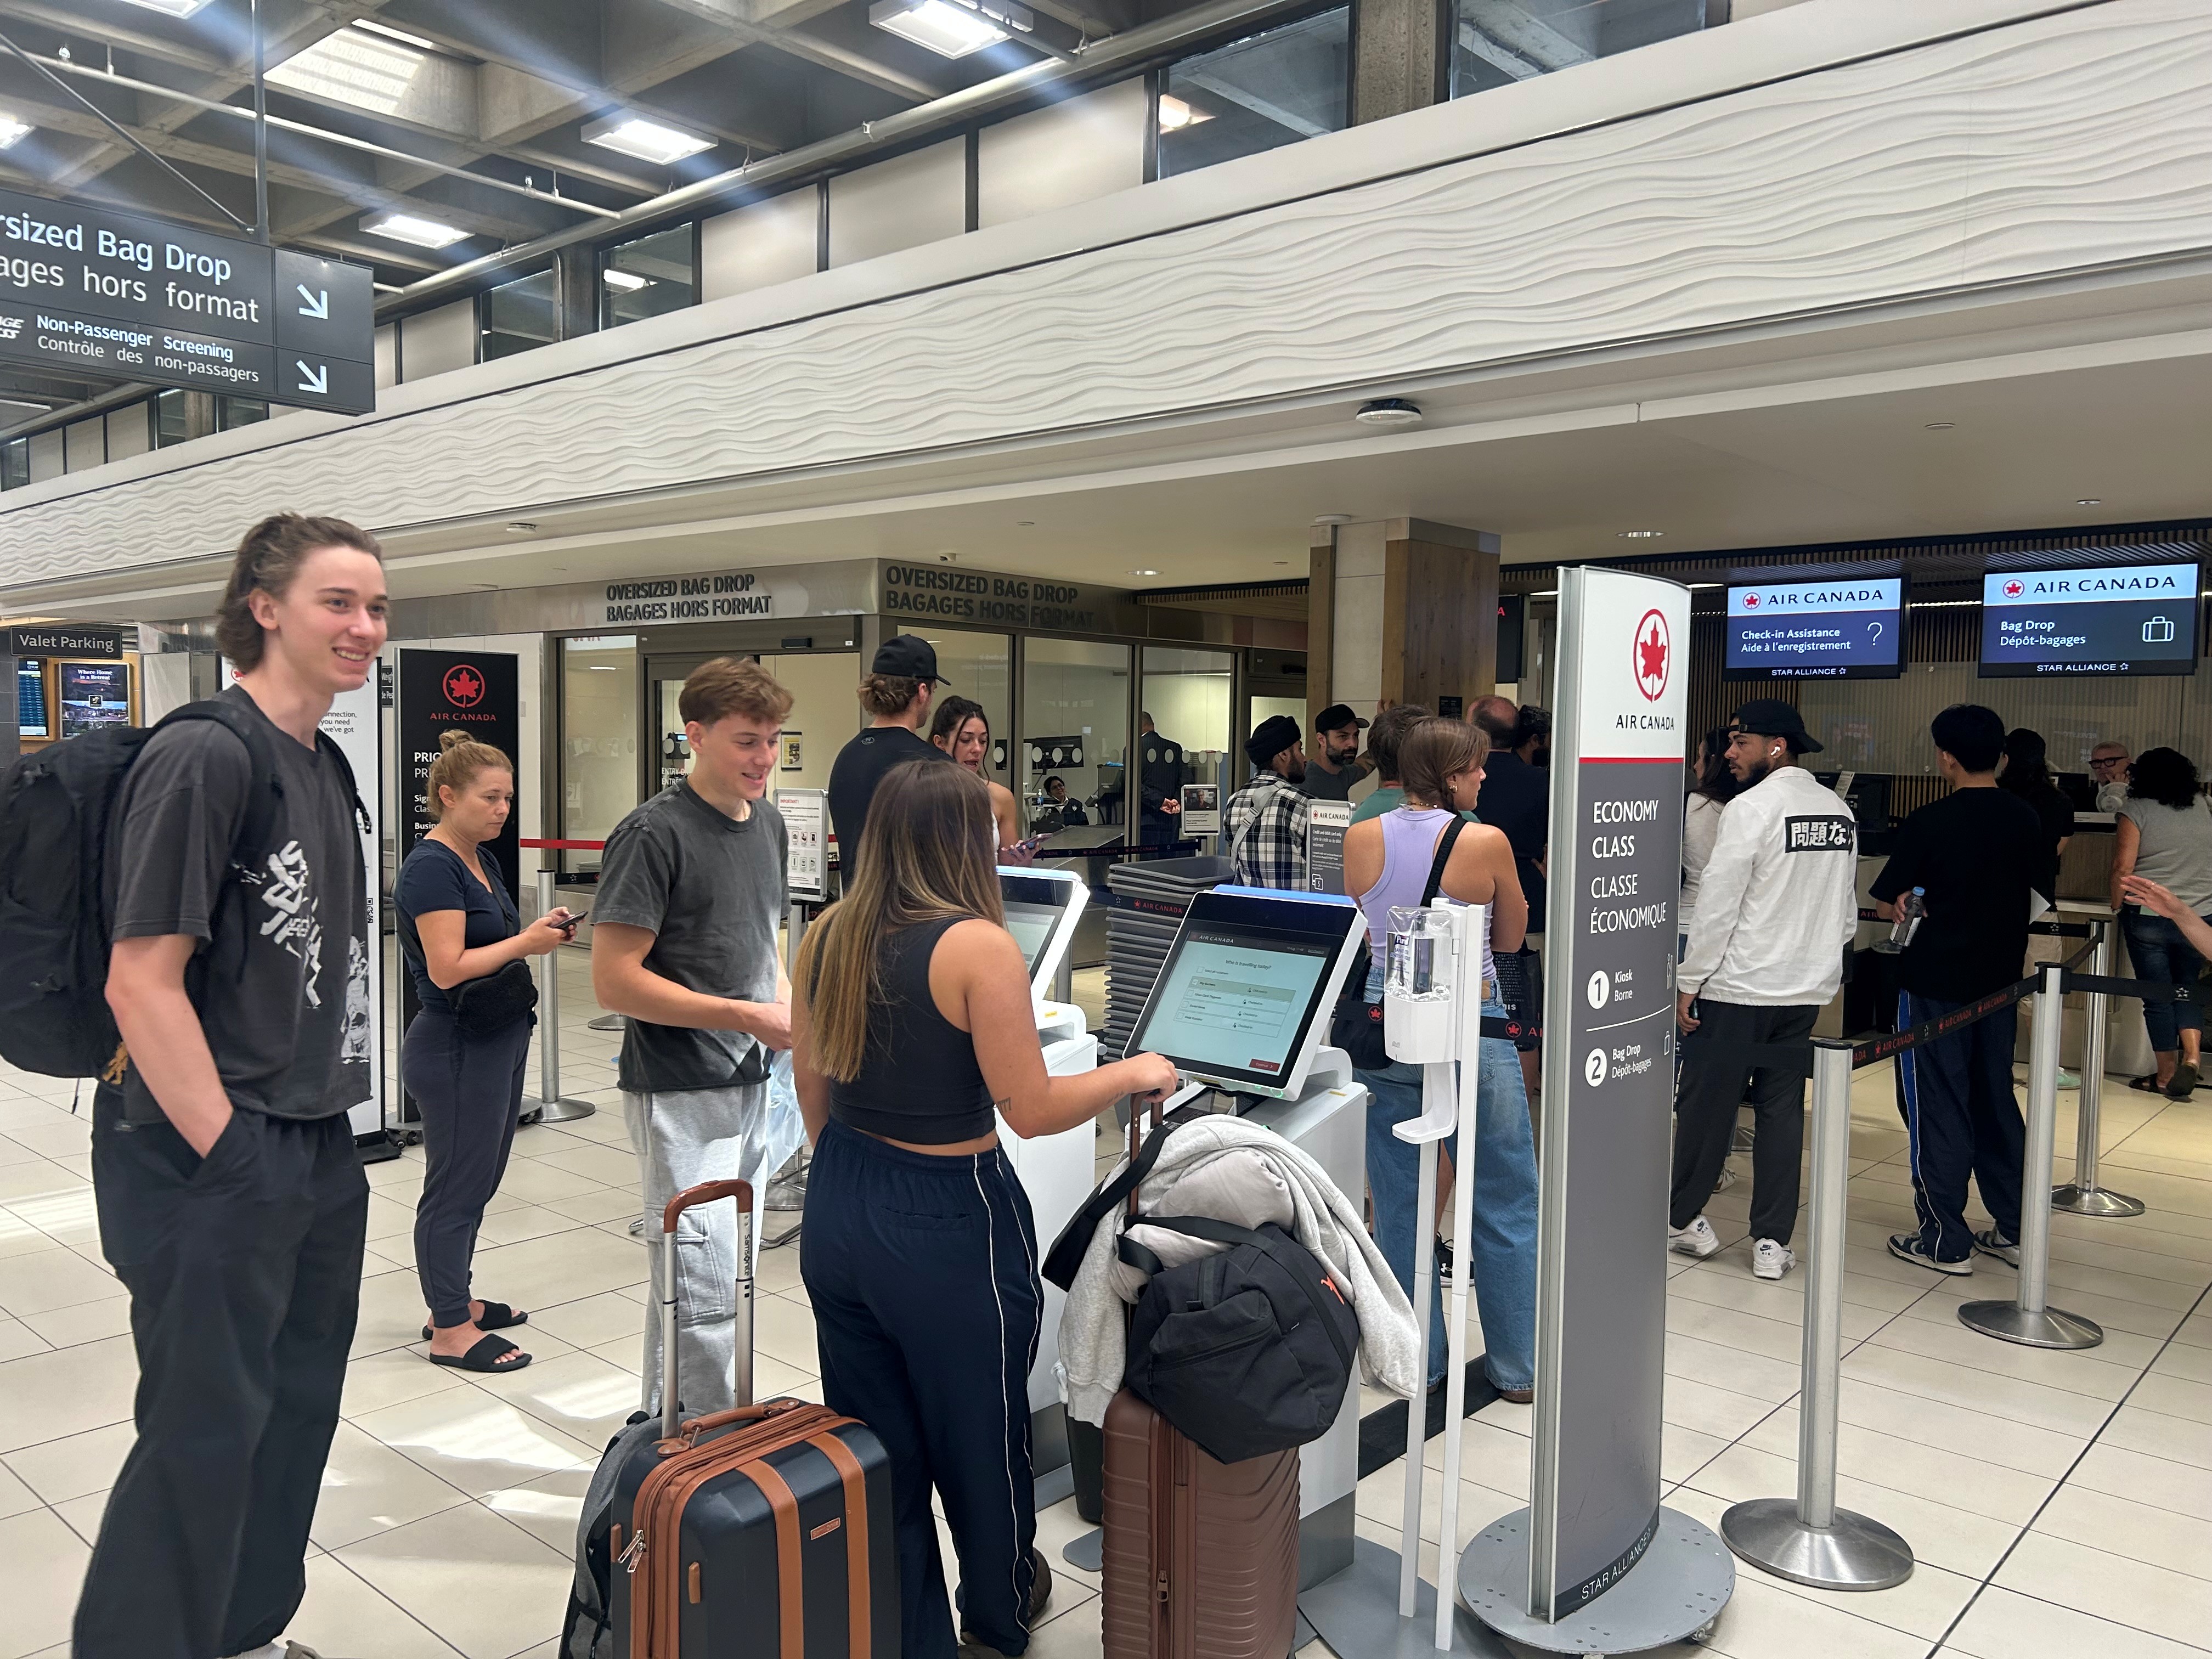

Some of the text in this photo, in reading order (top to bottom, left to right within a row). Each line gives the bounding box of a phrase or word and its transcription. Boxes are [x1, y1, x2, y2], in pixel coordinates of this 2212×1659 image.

[0, 212, 231, 285] sized Bag Drop
[83, 265, 147, 302] hors
[166, 282, 259, 323] format
[37, 314, 234, 363] Non-Passenger Screening
[38, 335, 259, 382] Contrôle des non-passagers
[606, 574, 754, 601] OVERSIZED BAG DROP
[887, 566, 1078, 604] OVERSIZED BAG DROP
[2033, 576, 2176, 594] AIR CANADA
[606, 596, 771, 622] BAGAGES HORS FORMAT
[886, 590, 1094, 627] BAGAGES HORS FORMAT
[1768, 590, 1883, 605] AIR CANADA
[1741, 628, 1840, 640] Check-in Assistance
[2001, 620, 2055, 633] Bag Drop
[19, 634, 114, 653] Valet Parking
[1741, 643, 1762, 652] Aide
[1764, 643, 1770, 652] à
[2000, 634, 2086, 648] Dépôt-bagages
[2065, 663, 2117, 671] ALLIANCE
[453, 713, 496, 721] CANADA
[1616, 714, 1674, 731] AIR CANADA
[1593, 800, 1658, 824] ECONOMY
[1592, 836, 1634, 859] CLASS
[1591, 873, 1638, 899] CLASSE
[1155, 904, 1182, 914] CANADA
[1590, 901, 1666, 934] ÉCONOMIQUE
[1615, 969, 1633, 983] Kiosk
[1594, 979, 1601, 1002] 1
[1614, 989, 1632, 1002] Borne
[1883, 1040, 1892, 1051] AIR
[1893, 1033, 1914, 1048] CANADA
[1945, 1018, 1953, 1028] AIR
[1953, 1009, 1971, 1024] CANADA
[1612, 1043, 1641, 1061] Bag Drop
[1591, 1056, 1601, 1080] 2
[1612, 1057, 1652, 1079] Dépôt-bagages
[1581, 1533, 1647, 1600] STAR ALLIANCE
